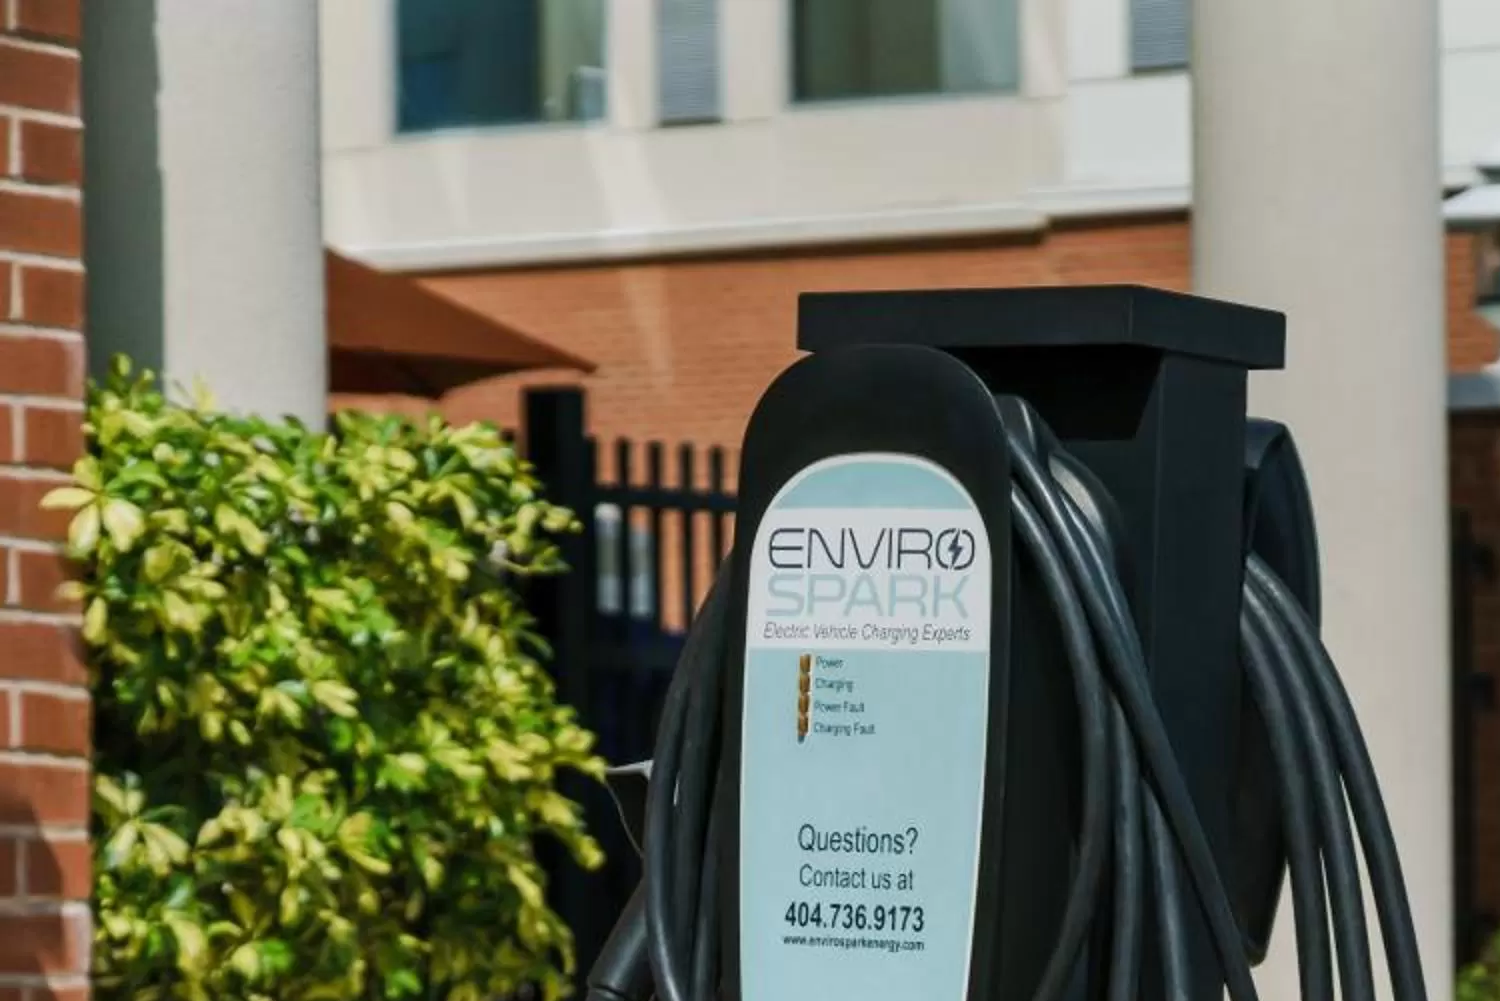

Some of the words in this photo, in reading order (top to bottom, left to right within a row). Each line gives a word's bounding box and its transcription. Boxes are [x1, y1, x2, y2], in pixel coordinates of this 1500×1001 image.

[769, 528, 975, 570] ENVIRO
[766, 572, 969, 619] SPARK
[763, 621, 810, 640] Electric
[814, 623, 857, 640] Vehicle
[861, 623, 919, 644] Charging
[922, 624, 971, 644] Experts
[798, 823, 919, 855] Questions?
[799, 863, 866, 889] Contact
[871, 871, 891, 890] us
[897, 870, 913, 891] at
[785, 901, 925, 932] 404.736.9173
[782, 935, 925, 953] www.envirosparkenergy.com
